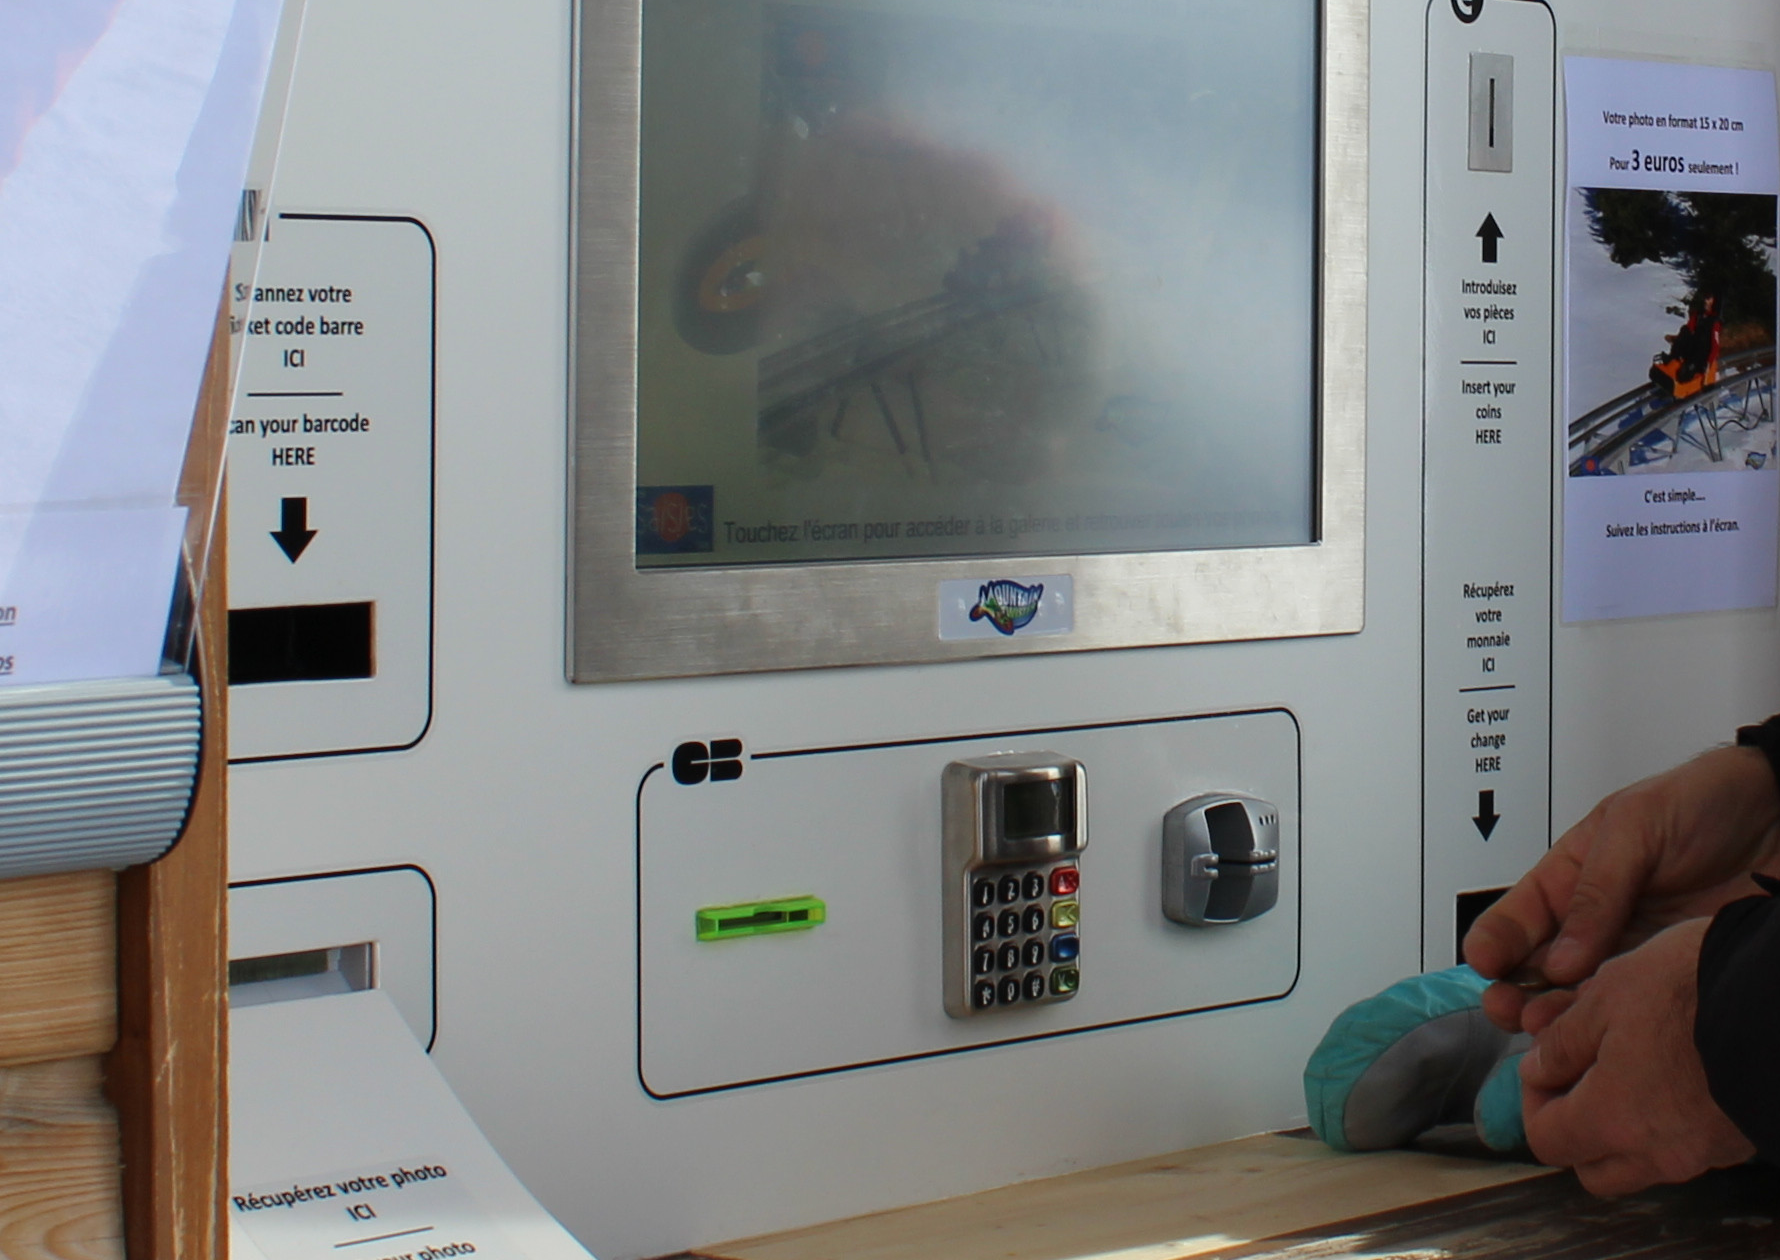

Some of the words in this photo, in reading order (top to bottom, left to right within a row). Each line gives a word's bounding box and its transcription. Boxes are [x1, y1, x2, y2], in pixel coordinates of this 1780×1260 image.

[1602, 111, 1627, 125] Votre
[1628, 112, 1654, 128] photo
[1656, 116, 1667, 127] en
[1668, 114, 1697, 129] format
[1700, 117, 1710, 130] 15
[1719, 117, 1730, 131] 20
[1731, 120, 1744, 131] cm
[1609, 156, 1630, 171] Pour
[1632, 149, 1640, 171] 3
[1644, 154, 1685, 173] euros
[1688, 160, 1734, 175] seulement
[308, 286, 352, 303] votre
[1462, 279, 1517, 296] Introduisez
[1464, 307, 1481, 319] vos
[1483, 305, 1514, 322] pièces
[275, 316, 315, 335] code
[320, 316, 364, 335] barre
[1483, 330, 1496, 345] ICI
[283, 349, 305, 368] ICI
[1462, 380, 1491, 395] Insert
[1493, 381, 1515, 397] your
[1476, 404, 1502, 419] coins
[259, 419, 299, 438] your
[303, 413, 369, 433] barcode
[1476, 430, 1502, 445] HERE
[272, 447, 315, 466] HERE
[1645, 490, 1666, 503] C'est
[724, 521, 798, 544] Touchez
[804, 516, 858, 541] l'écran
[864, 520, 901, 543] pour
[906, 515, 970, 538] accéder
[975, 515, 986, 536] à
[990, 514, 1003, 536] la
[1606, 523, 1635, 538] Suivez
[1636, 522, 1649, 536] les
[1651, 521, 1701, 535] instructions
[1703, 520, 1708, 532] à
[1463, 582, 1514, 599] Récupérez
[1475, 608, 1502, 623] votre
[1466, 632, 1510, 648] monnaie
[1482, 658, 1495, 672] ICI
[1467, 709, 1485, 724] Get
[1487, 709, 1509, 725] your
[1470, 732, 1506, 749] change
[1475, 756, 1501, 773] HERE
[233, 1184, 336, 1212] Récupérez
[336, 1174, 389, 1194] votre
[390, 1164, 447, 1188] photo
[346, 1202, 377, 1222] ICI
